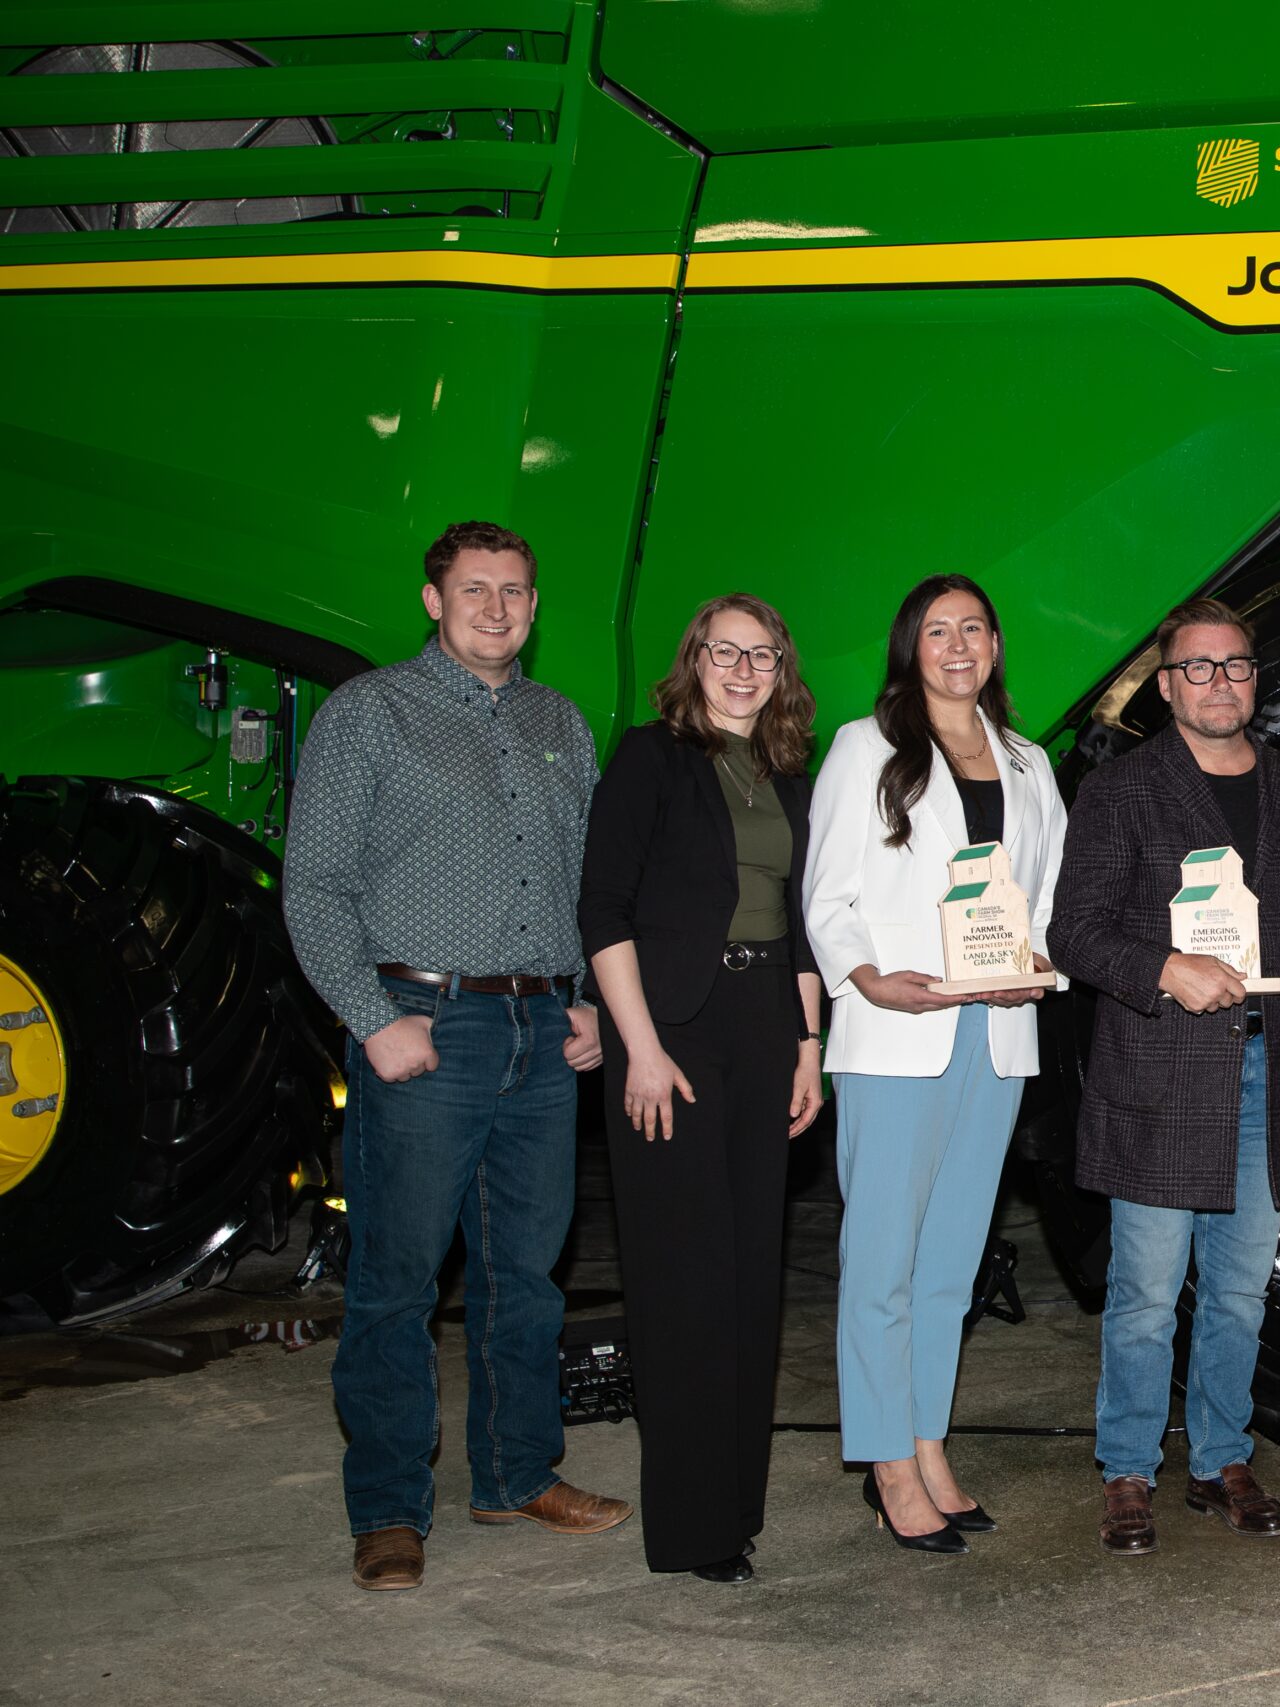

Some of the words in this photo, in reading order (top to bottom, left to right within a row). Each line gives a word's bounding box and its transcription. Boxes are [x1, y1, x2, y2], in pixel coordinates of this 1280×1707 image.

[971, 925, 1004, 933] FARMER
[1192, 927, 1238, 936] EMERGING
[963, 932, 1013, 942] INNOVATOR
[1190, 934, 1241, 943] INNOVATOR
[966, 942, 1003, 950] PRESENTED
[1192, 944, 1230, 952] PRESENTED
[963, 952, 987, 961] LAND
[973, 957, 1006, 966] GRAINS
